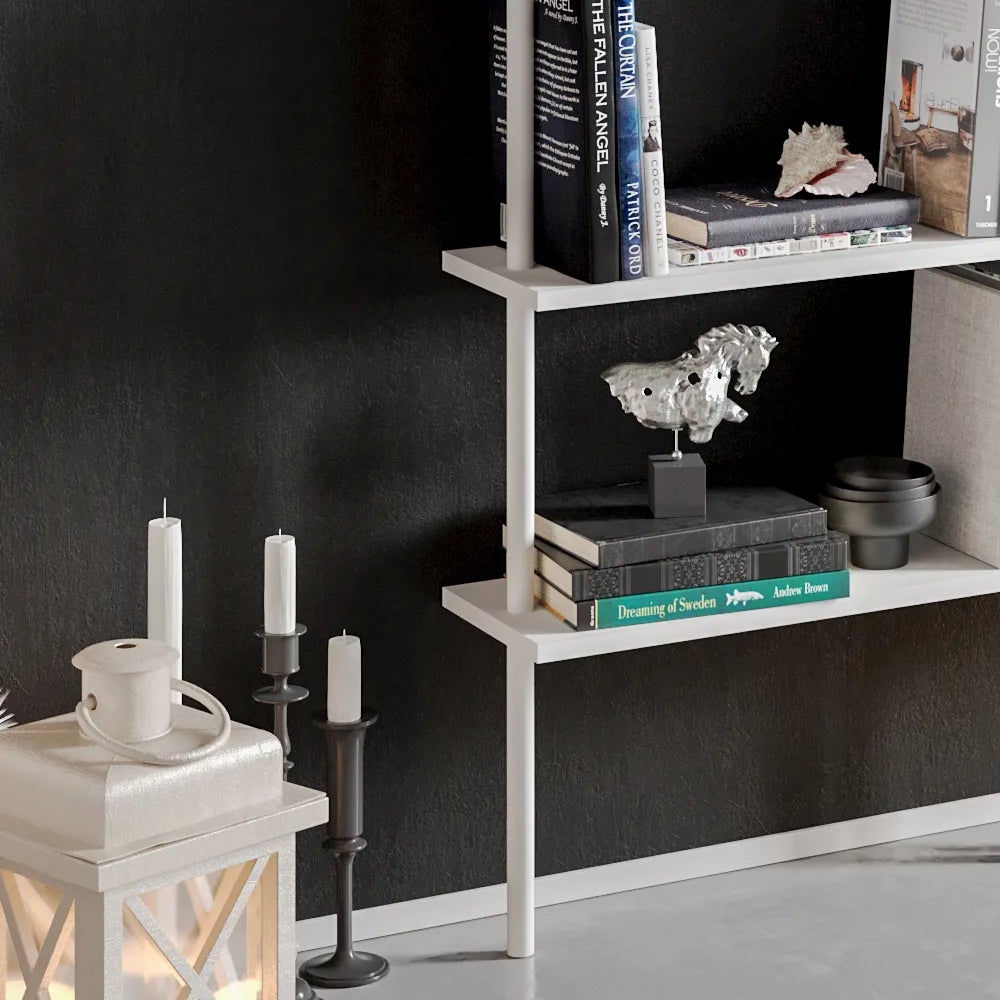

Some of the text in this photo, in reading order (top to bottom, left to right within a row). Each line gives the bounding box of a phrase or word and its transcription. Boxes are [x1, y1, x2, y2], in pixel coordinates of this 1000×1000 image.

[594, 38, 608, 106] FALLEN
[617, 2, 637, 99] THE CURTAIN
[985, 28, 1000, 72] NOW!
[646, 72, 654, 110] CHANEY
[595, 110, 609, 173] ANGEL
[626, 182, 642, 276] PATRICK ORD
[651, 159, 666, 253] COCO CHANEL
[985, 194, 992, 212] 1
[617, 595, 716, 620] Dreaming of Sweden
[773, 581, 829, 598] Andrew Brown
